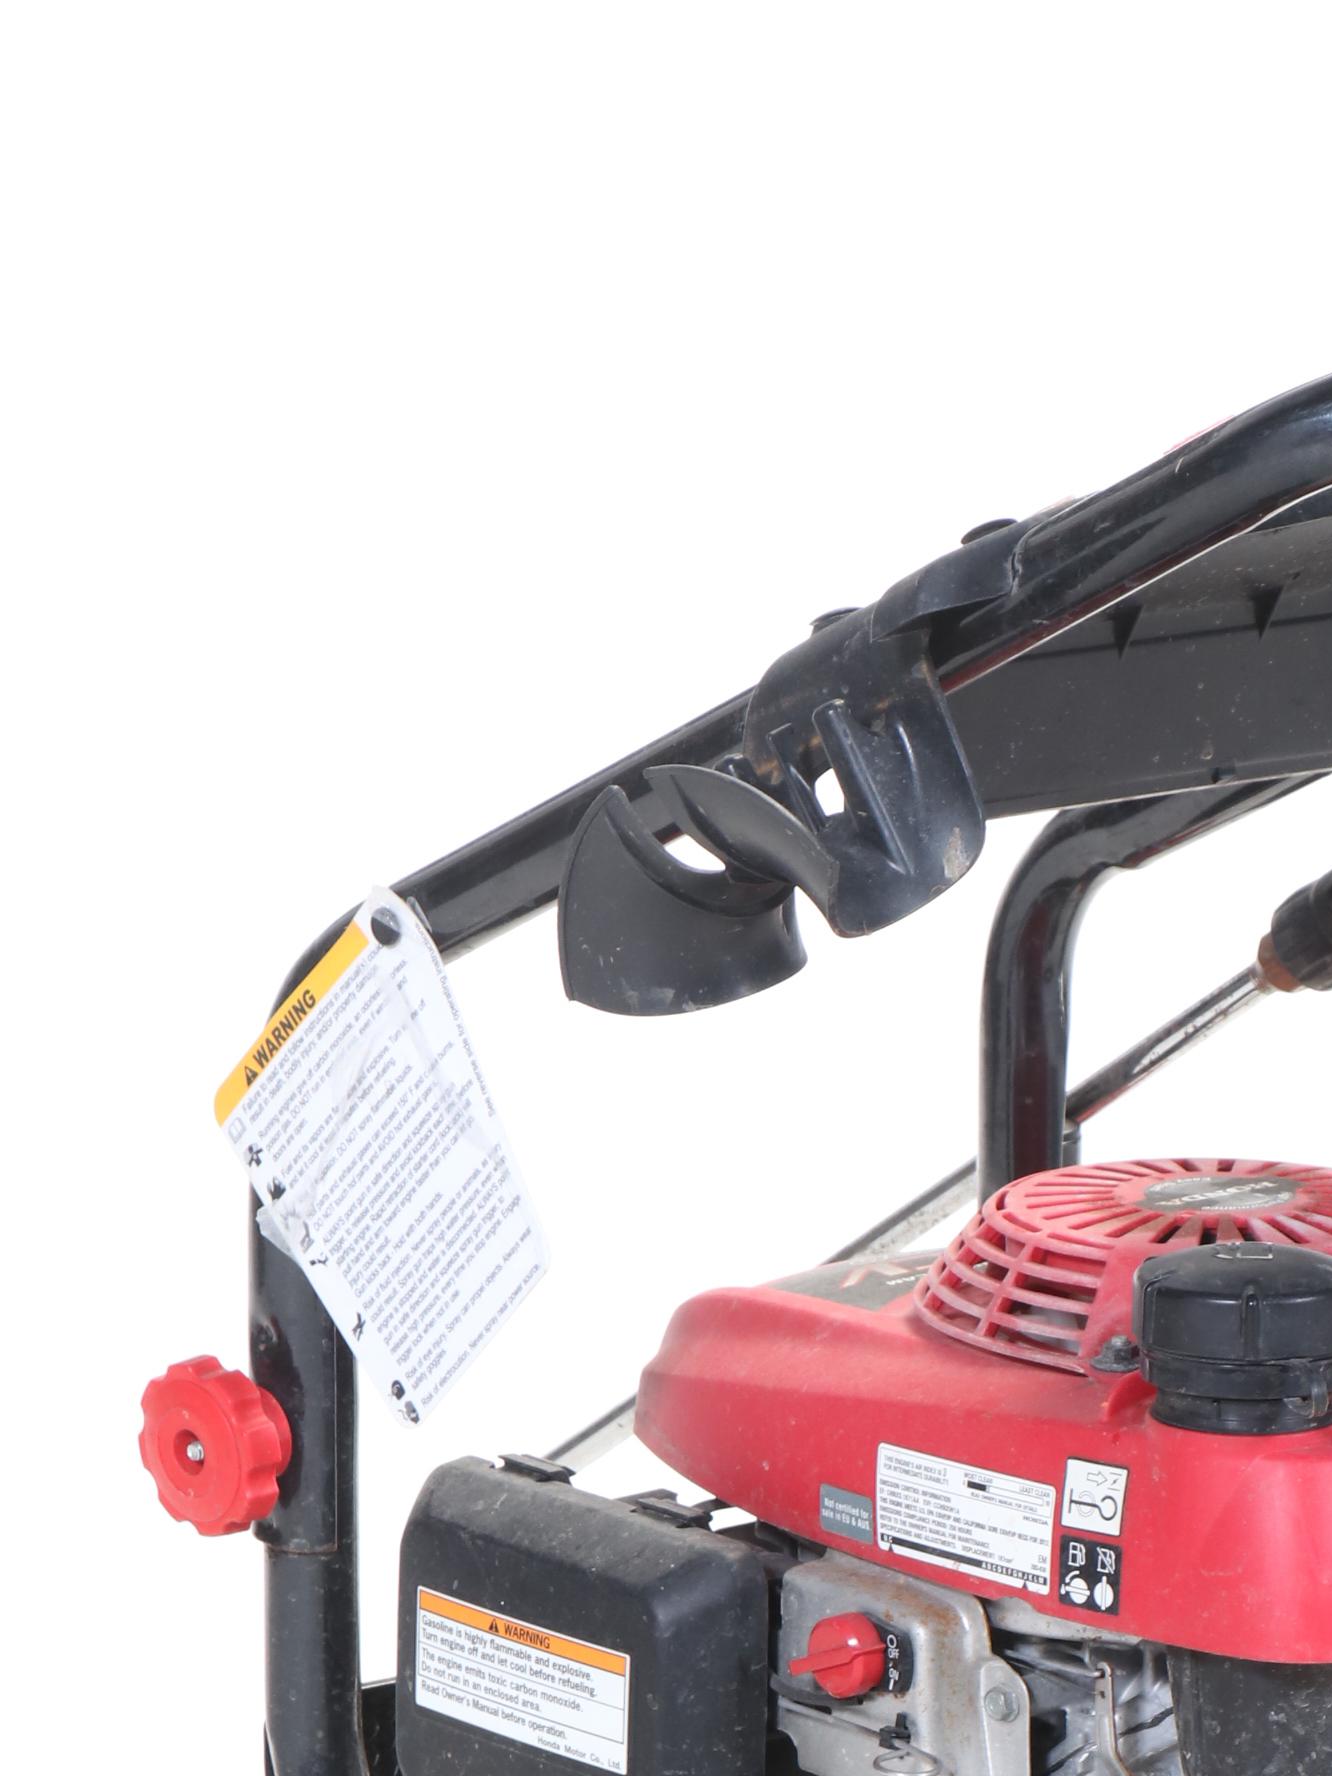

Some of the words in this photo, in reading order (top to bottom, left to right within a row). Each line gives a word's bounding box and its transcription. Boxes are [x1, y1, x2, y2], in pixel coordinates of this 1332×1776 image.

[253, 988, 317, 1068] WARNING
[822, 1507, 833, 1518] sale
[834, 1511, 840, 1521] in
[824, 1497, 834, 1508] Not
[835, 1501, 859, 1516] certified
[860, 1507, 868, 1520] for
[422, 1614, 452, 1635] Gasoline
[456, 1626, 461, 1638] is
[464, 1629, 487, 1649] highly
[489, 1637, 531, 1662] flammable
[534, 1652, 549, 1668] and
[422, 1628, 437, 1642] Turn
[440, 1635, 465, 1654] engine
[468, 1644, 478, 1657] off
[481, 1649, 494, 1663] and
[497, 1654, 507, 1667] let
[510, 1659, 526, 1673] cool
[529, 1665, 555, 1683] before
[504, 1622, 550, 1650] WARNING
[421, 1662, 431, 1673] Do
[433, 1666, 445, 1679] not
[448, 1672, 459, 1684] run
[463, 1676, 469, 1687] in
[471, 1681, 481, 1691] an
[483, 1684, 518, 1704] enclosed
[422, 1647, 434, 1662] The
[437, 1653, 462, 1673] engine
[465, 1663, 485, 1679] emits
[488, 1671, 506, 1687] toxic
[510, 1678, 537, 1697] carbon
[421, 1679, 439, 1695] Read
[472, 1697, 498, 1717] Manual
[501, 1708, 525, 1726] before
[537, 1734, 559, 1750] Honda
[564, 1743, 586, 1759] Motor
